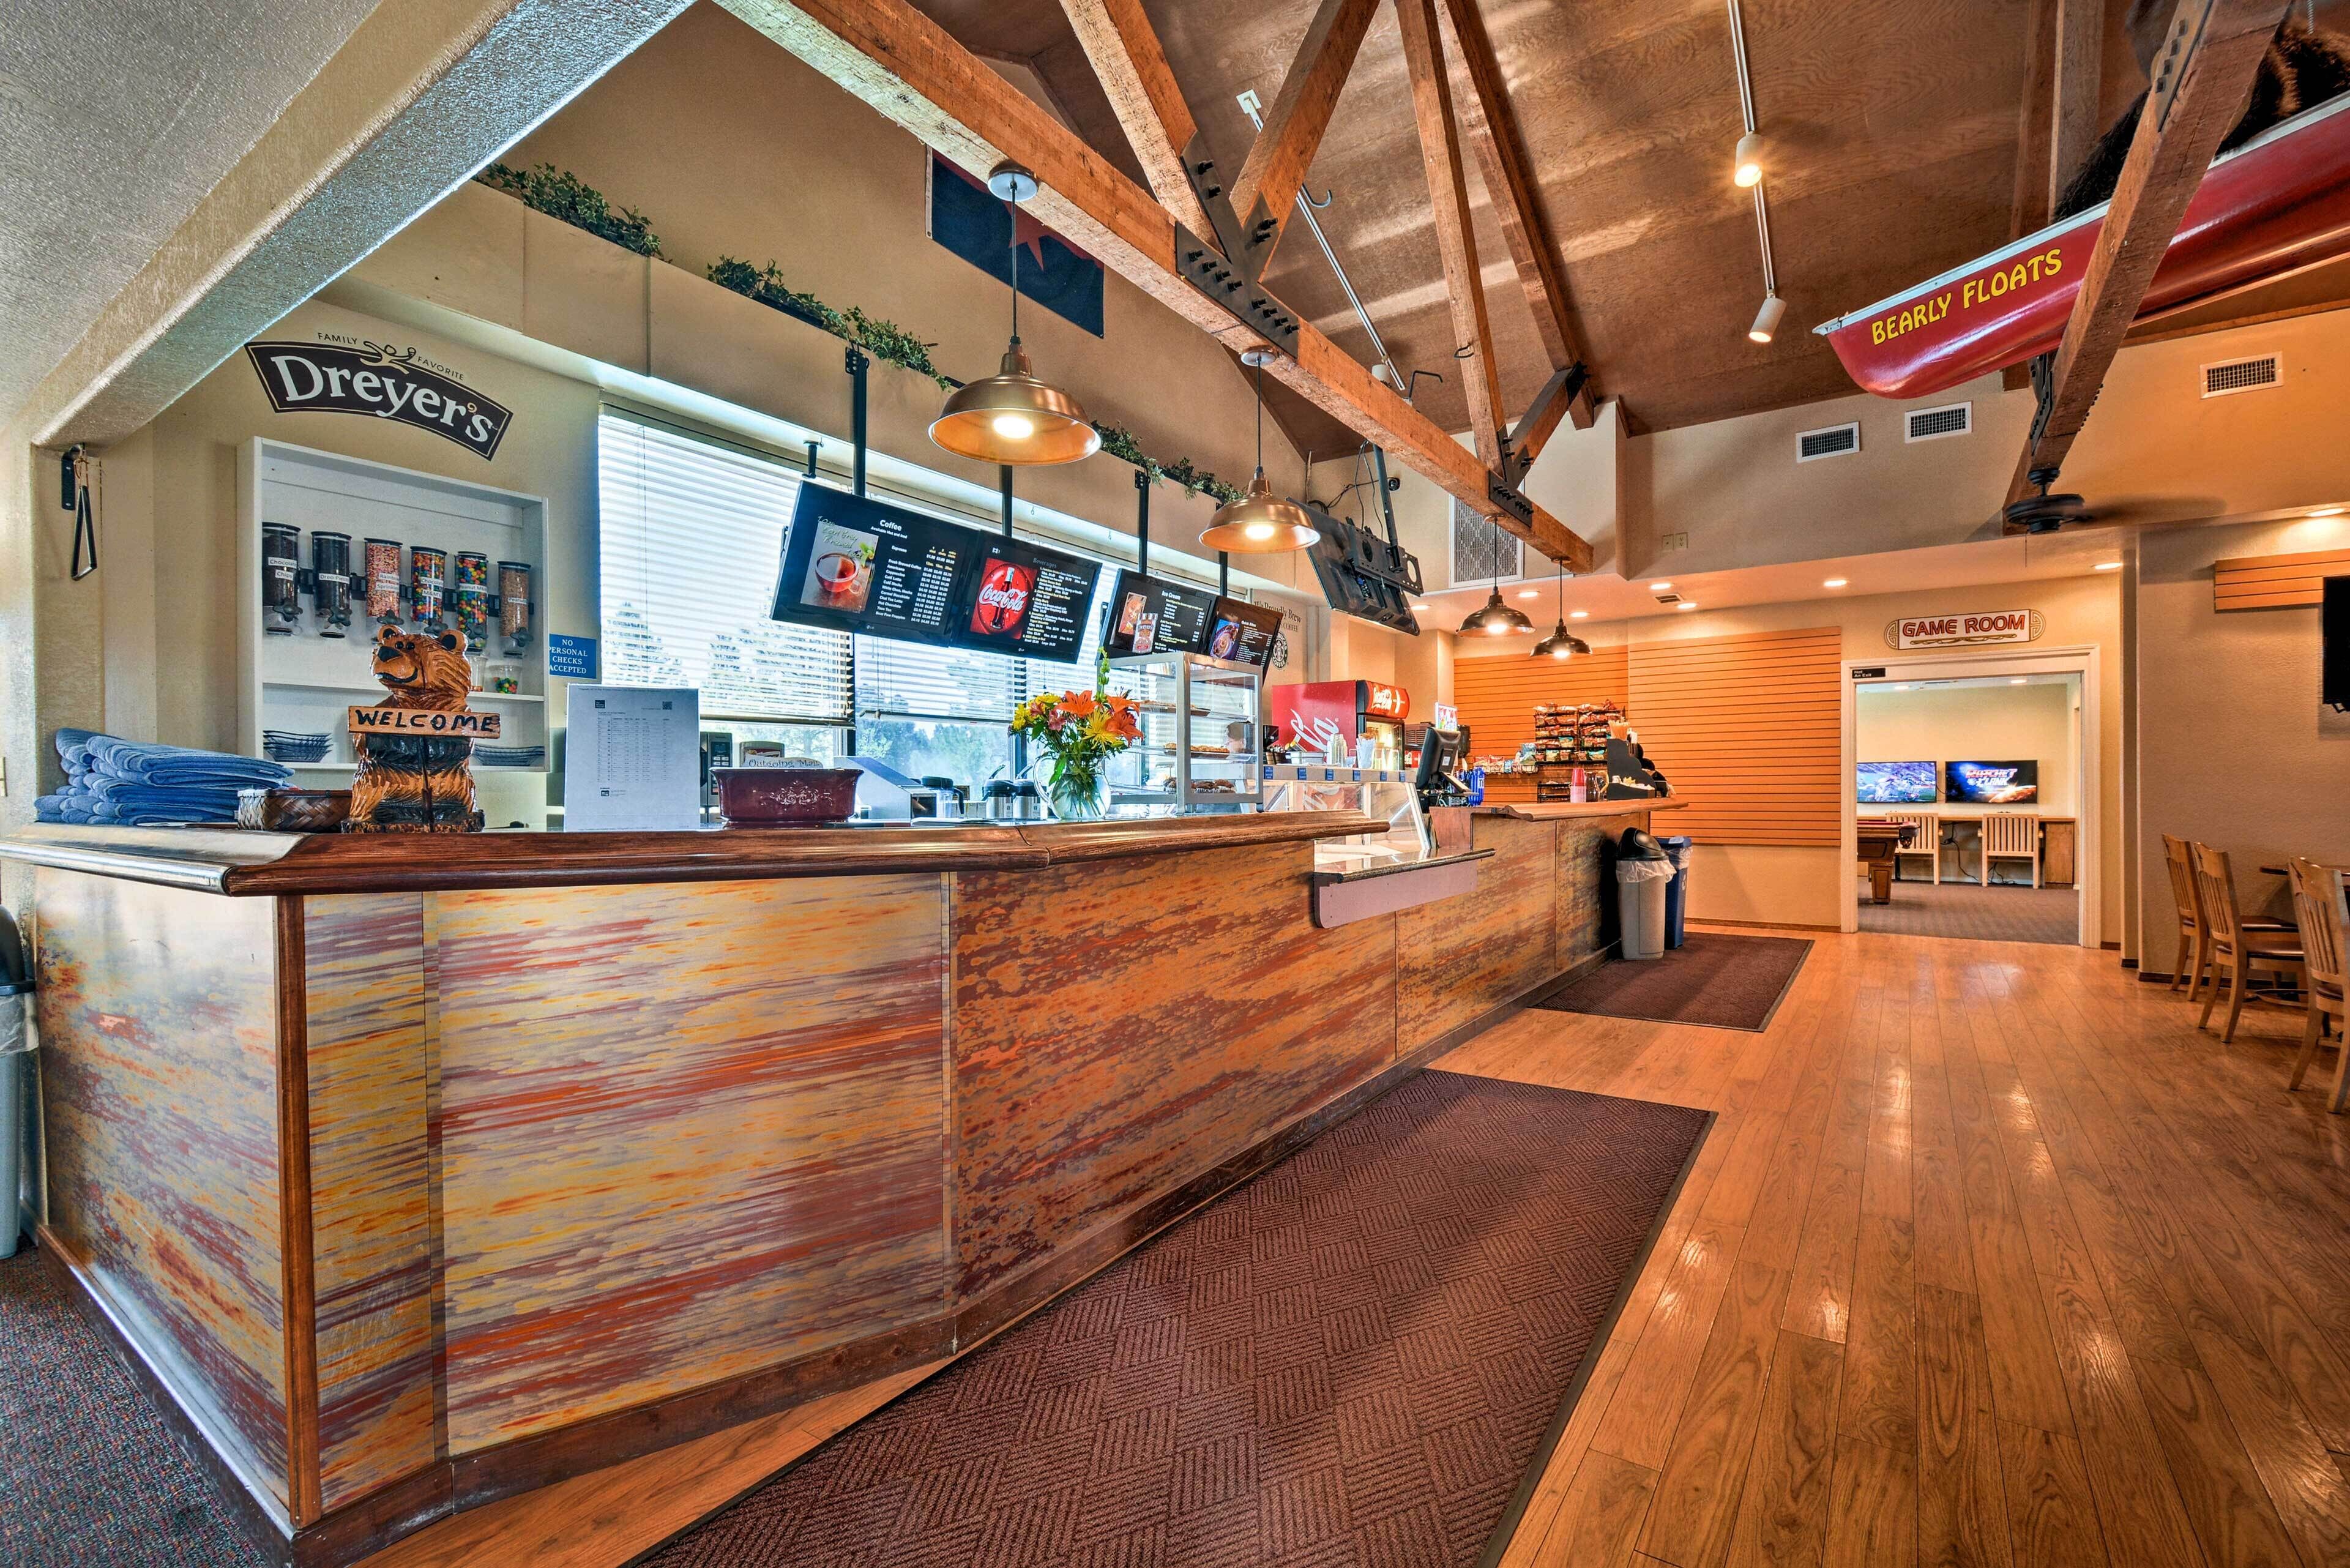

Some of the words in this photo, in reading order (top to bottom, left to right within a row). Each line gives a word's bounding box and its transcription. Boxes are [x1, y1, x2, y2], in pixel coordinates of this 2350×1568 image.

[1871, 293, 1952, 346] BEARLY
[1963, 248, 2063, 309] FLOATS
[318, 332, 358, 345] FAMILY
[417, 355, 464, 381] FAVORITE
[270, 355, 494, 442] Dreyer's
[879, 520, 902, 532] Coffee
[1033, 558, 1057, 569] Beverages
[277, 570, 293, 579] Chips
[1168, 592, 1181, 600] Cream
[1288, 608, 1302, 622] Brew
[1902, 618, 1958, 638] GAME
[1964, 614, 2026, 633] ROOM
[549, 646, 588, 657] PERSONAL
[552, 655, 583, 665] CHECKS
[548, 665, 587, 674] ACCEPTED
[355, 709, 498, 732] WELCOME
[748, 758, 794, 768] Outgoing
[1965, 768, 2018, 778] RATCHET
